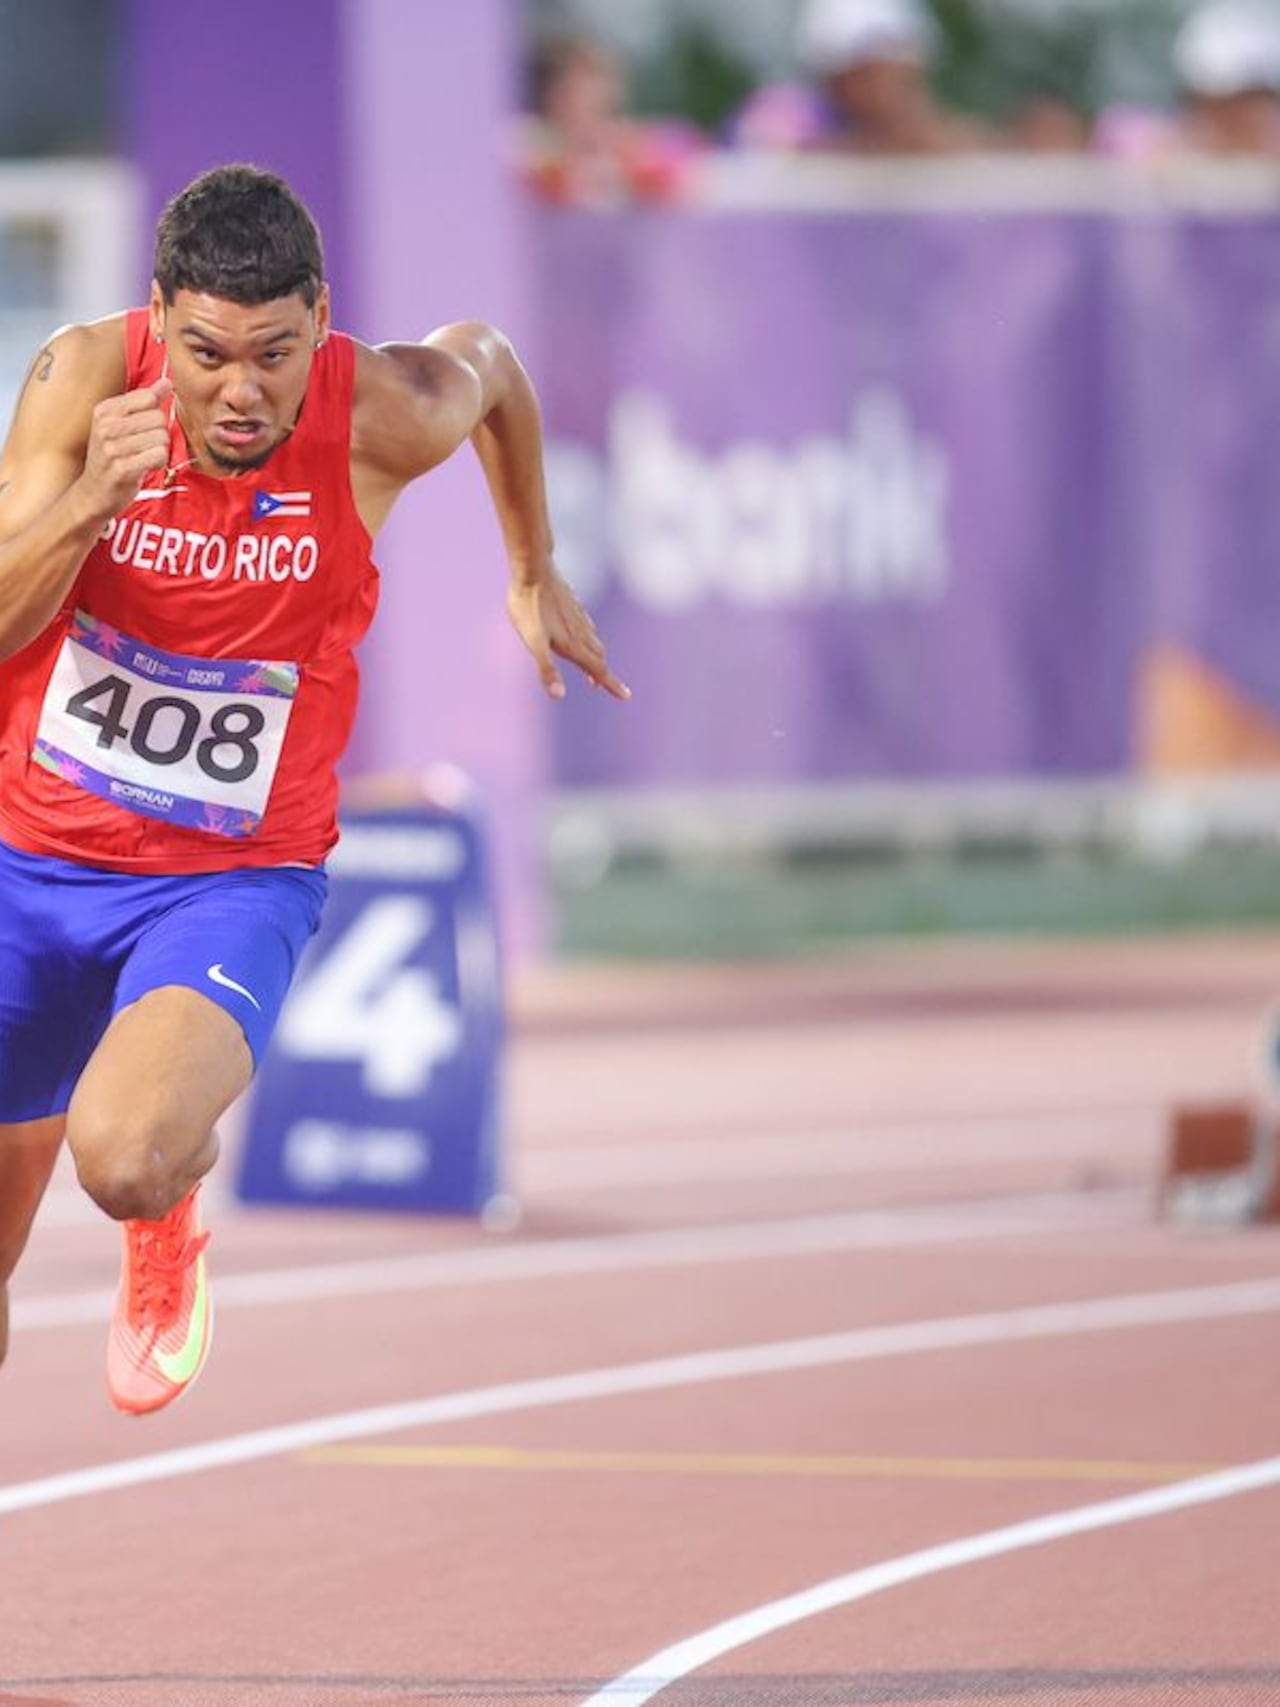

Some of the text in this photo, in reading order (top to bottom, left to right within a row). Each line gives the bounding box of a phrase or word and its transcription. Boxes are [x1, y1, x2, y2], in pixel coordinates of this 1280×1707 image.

[232, 534, 319, 582] RICO
[65, 673, 266, 784] 408
[278, 895, 461, 1099] 4
